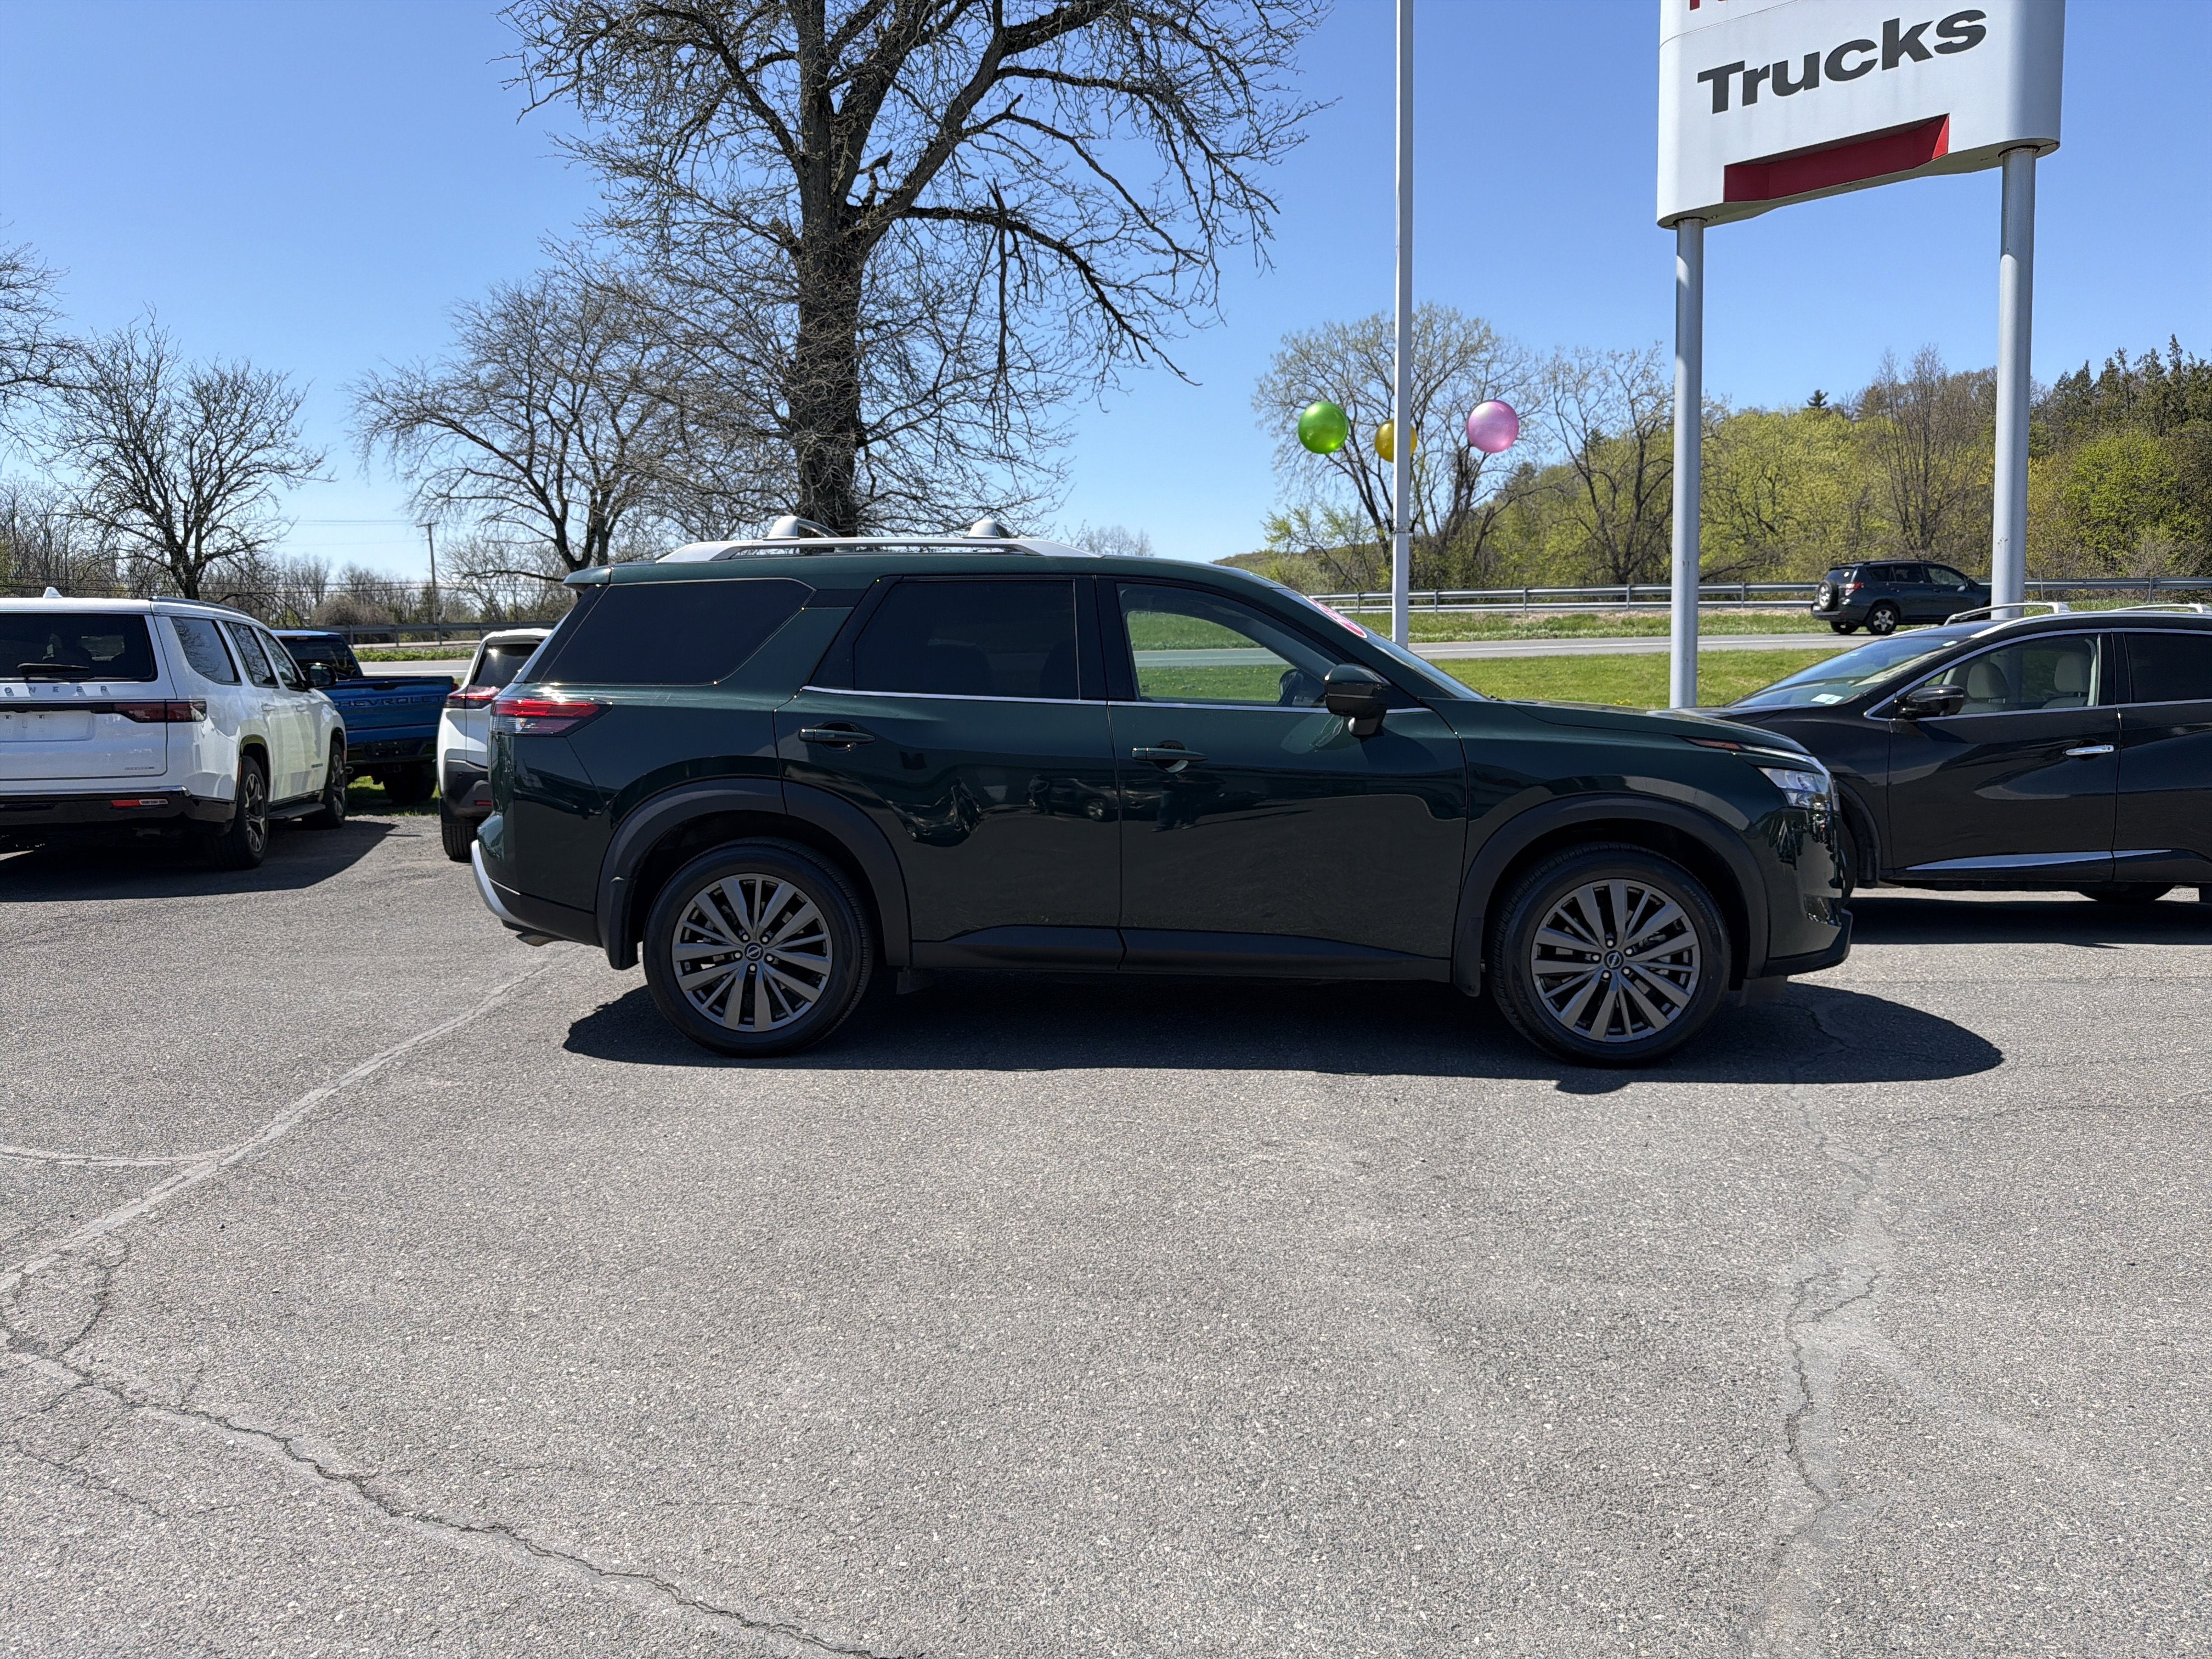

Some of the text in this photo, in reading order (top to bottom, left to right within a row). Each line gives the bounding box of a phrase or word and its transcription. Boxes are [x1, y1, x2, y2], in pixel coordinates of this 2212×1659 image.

[1697, 9, 1987, 114] Trucks
[3, 685, 108, 693] ONEER
[335, 694, 444, 707] HEVROLET
